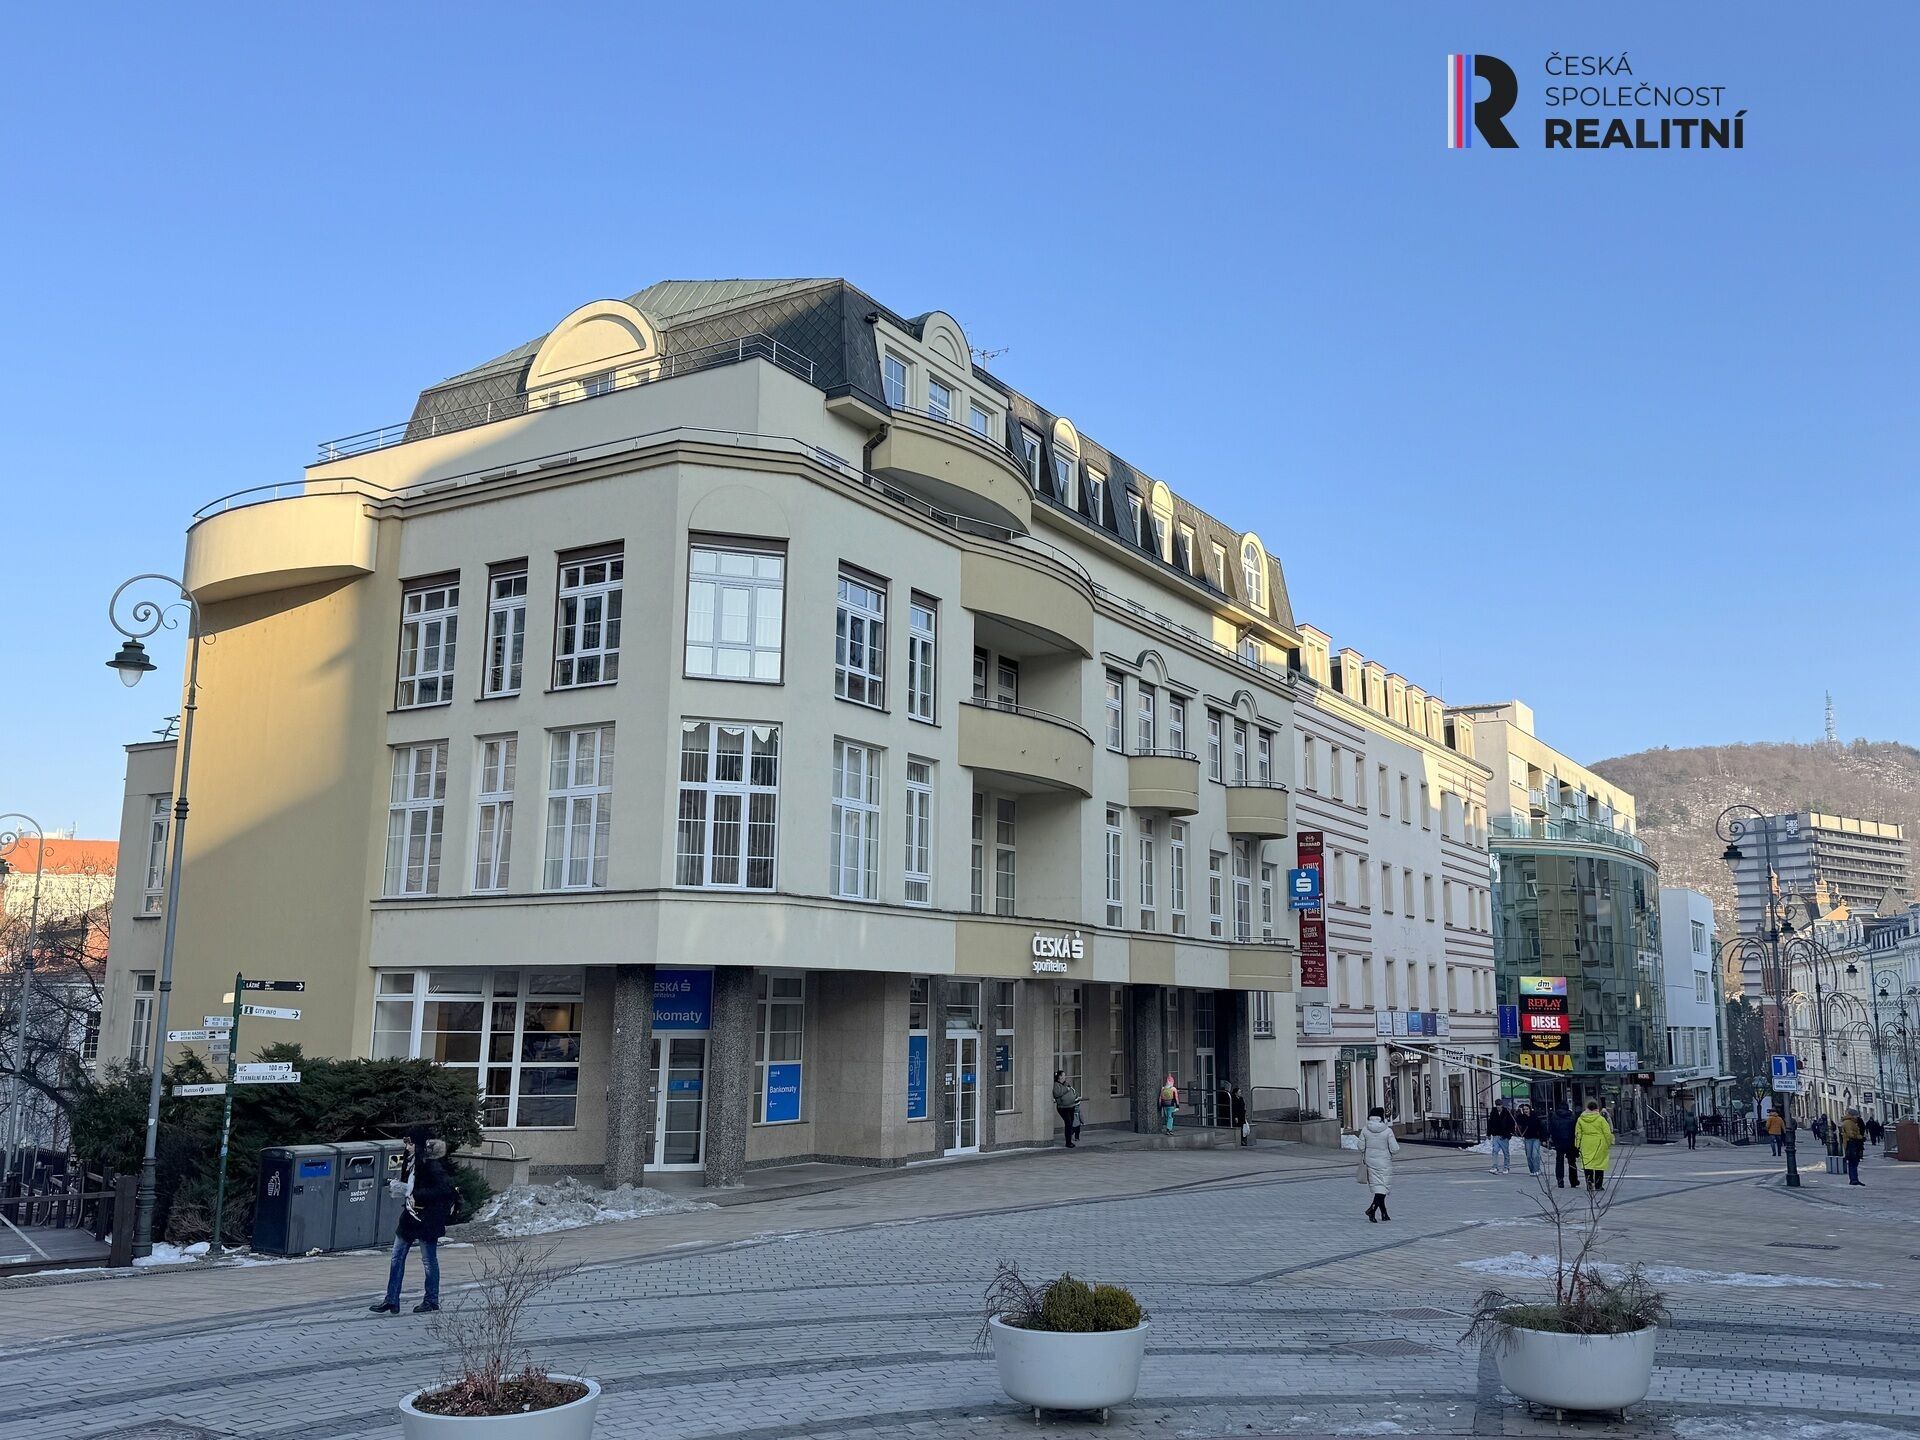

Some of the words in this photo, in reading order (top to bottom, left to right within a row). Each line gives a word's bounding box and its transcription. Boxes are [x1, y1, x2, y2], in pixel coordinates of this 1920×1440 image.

[1032, 931, 1071, 959] ČESKÁ
[1032, 959, 1068, 973] spořitelna
[653, 980, 679, 992] ESKÁ
[1537, 980, 1550, 988] dm
[1528, 998, 1562, 1008] REPLAY
[653, 1009, 702, 1024] komaty
[1530, 1016, 1561, 1029] DIESEL
[1520, 1054, 1574, 1072] BILLA
[769, 1085, 797, 1094] Bankomaty
